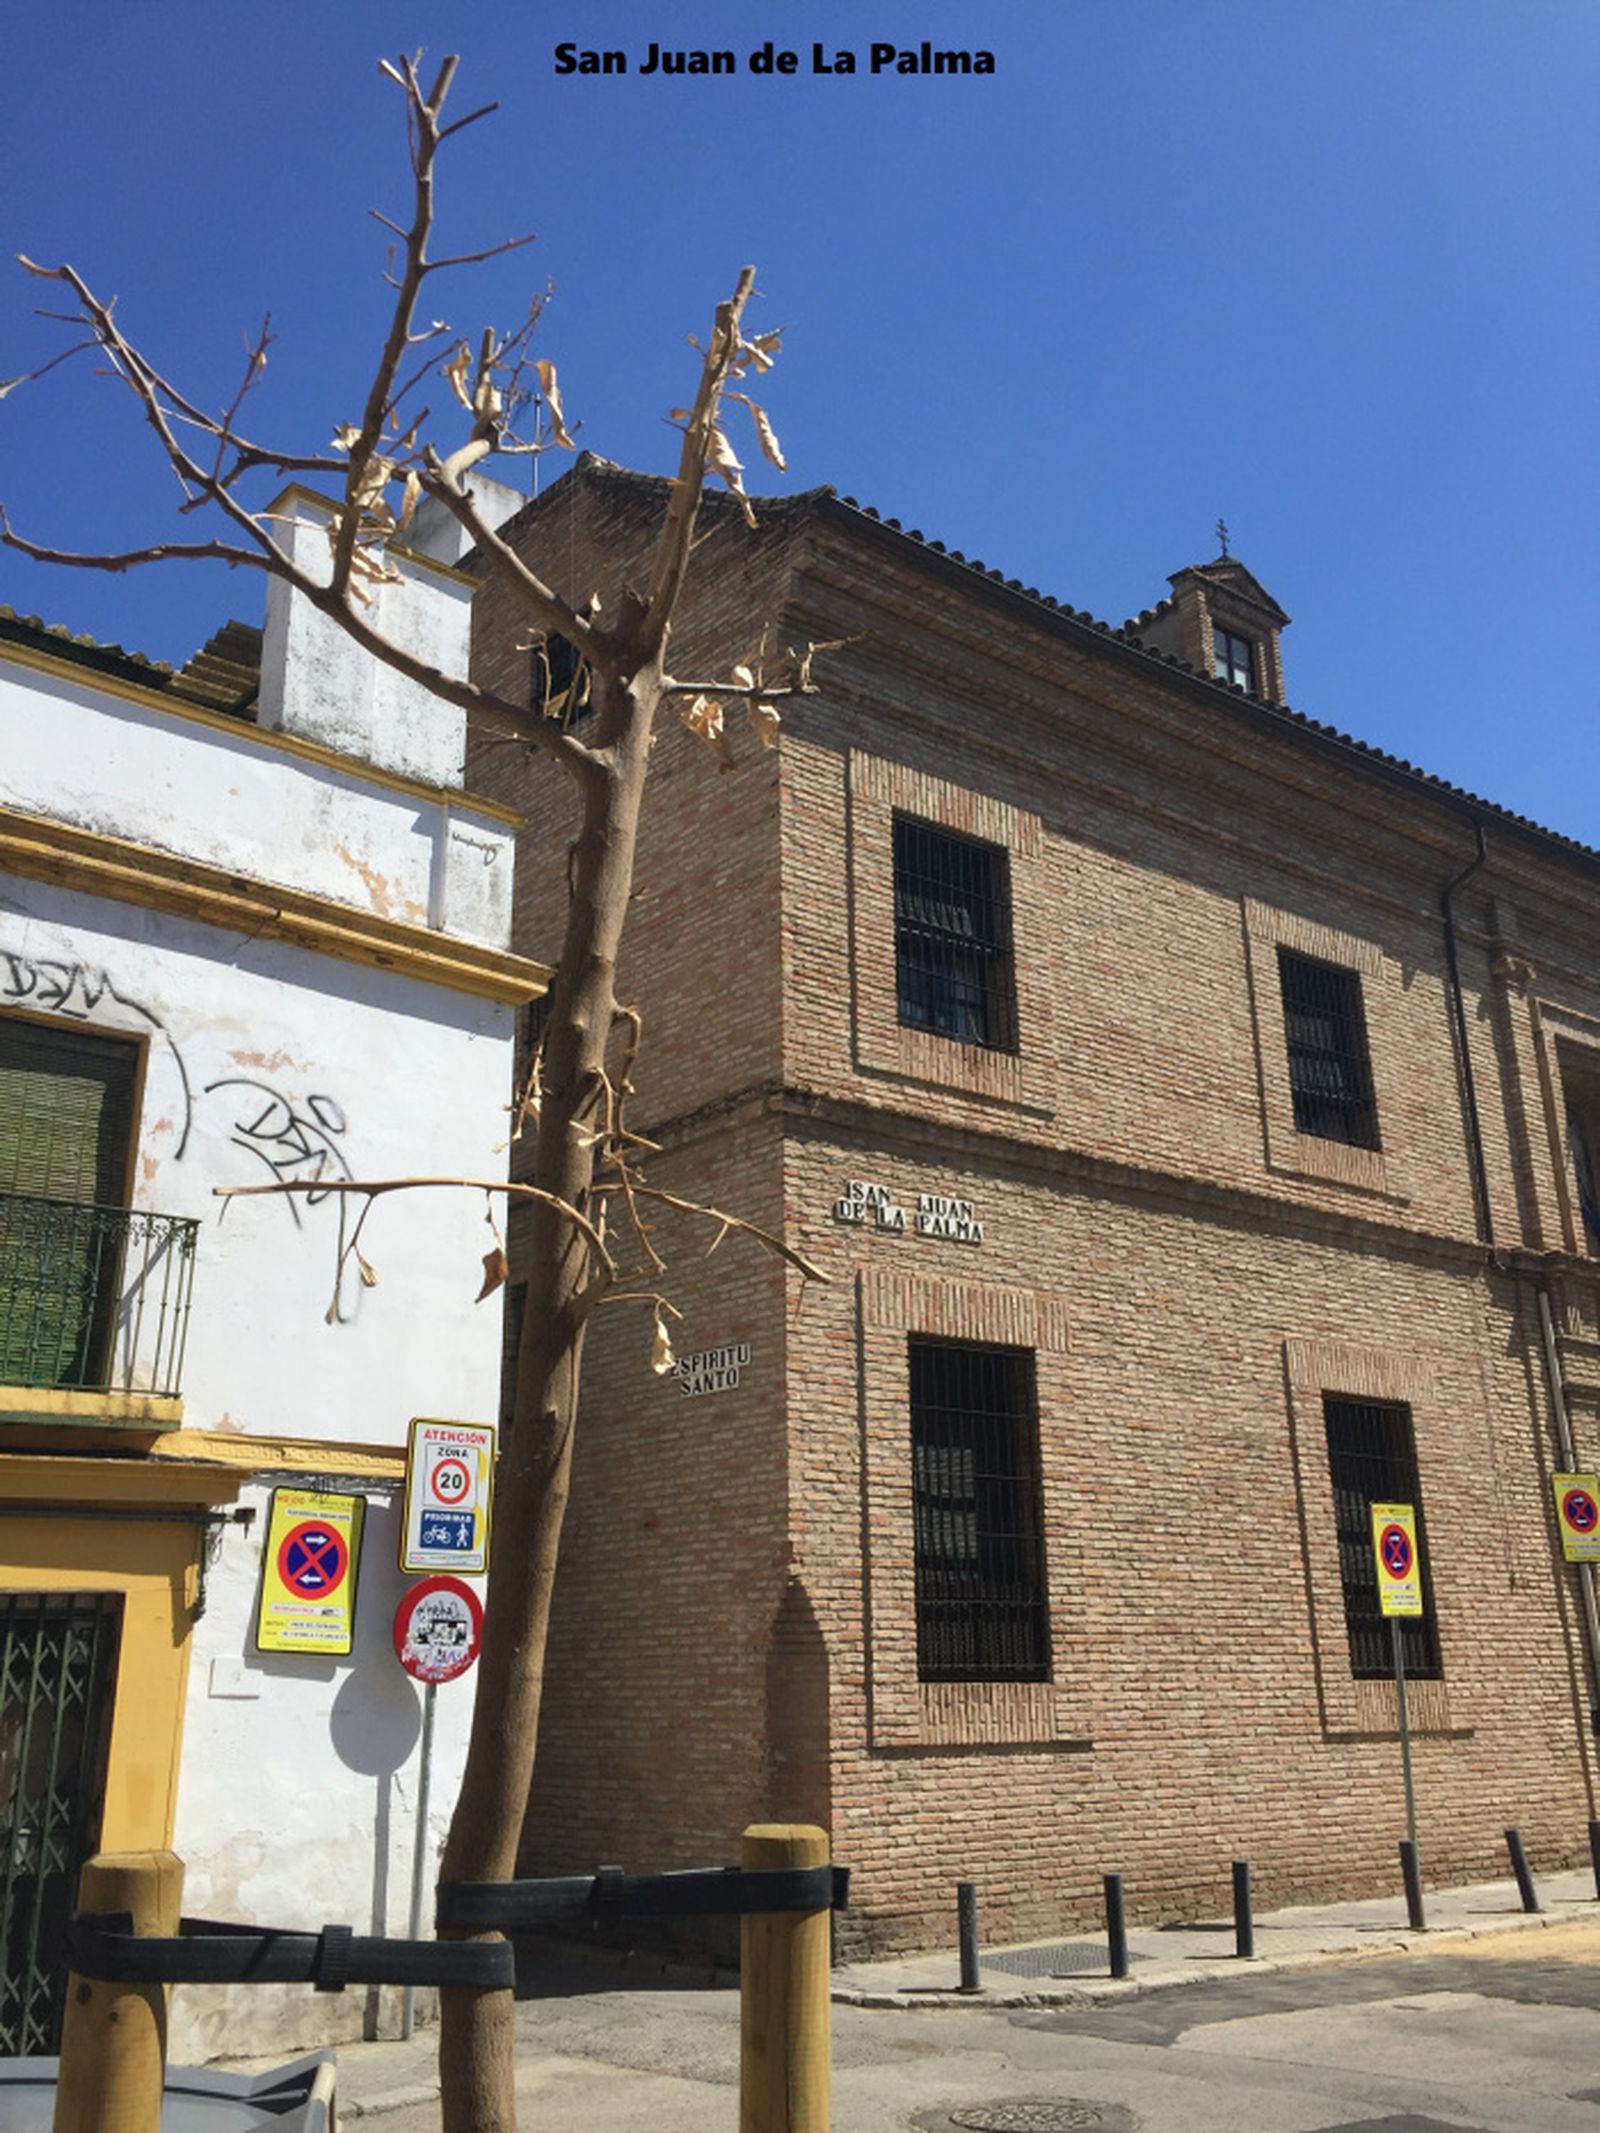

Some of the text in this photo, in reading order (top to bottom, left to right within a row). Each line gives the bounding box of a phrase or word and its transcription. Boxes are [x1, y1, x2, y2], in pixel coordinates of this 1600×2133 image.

[851, 1181, 973, 1220] SAN JUAN
[839, 1199, 982, 1242] DE LA PALMA
[680, 1367, 737, 1396] SANTO
[424, 1429, 487, 1444] ATENCIÓN
[437, 1447, 469, 1458] ZONA
[440, 1471, 463, 1490] 20
